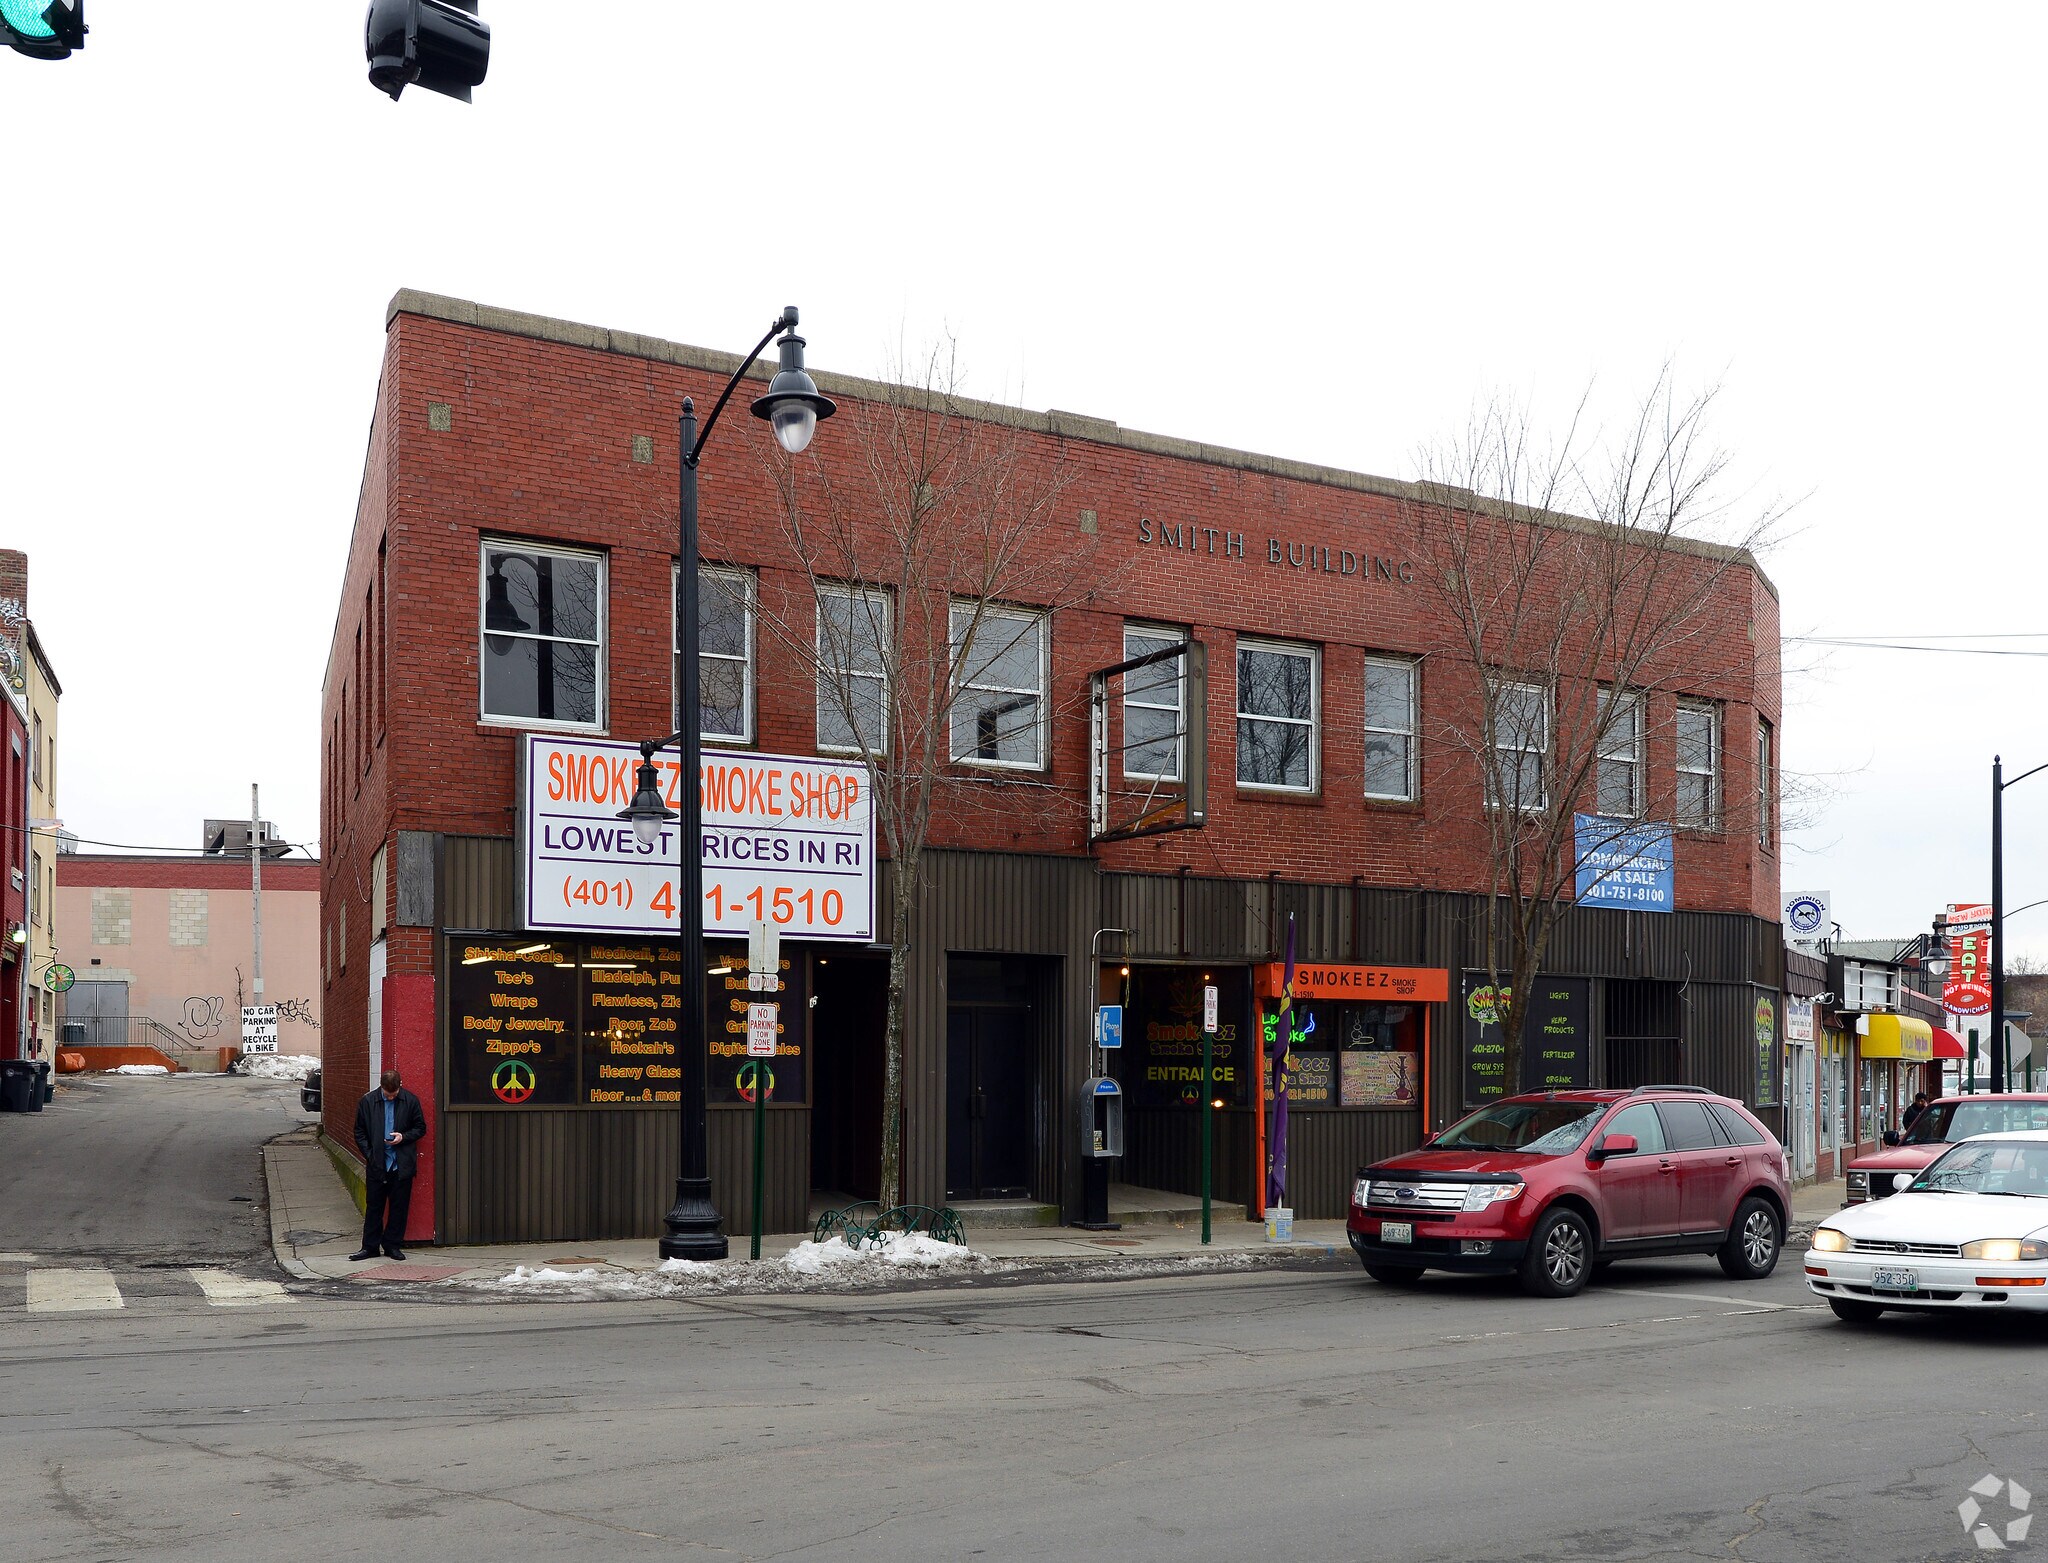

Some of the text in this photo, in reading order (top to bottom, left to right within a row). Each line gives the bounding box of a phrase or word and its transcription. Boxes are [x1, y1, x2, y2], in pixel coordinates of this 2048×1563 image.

[1138, 518, 1414, 584] SMITH BUILDING
[789, 771, 859, 821] SHOP
[701, 834, 790, 862] RICES
[799, 840, 826, 864] IN
[835, 842, 860, 866] RI
[1581, 851, 1667, 870] COMMERCIAL
[1595, 868, 1656, 885] FOR SALE
[563, 875, 844, 926] (401) 41-1510
[1785, 896, 1826, 913] DOMINION
[1802, 923, 1823, 934] Control
[1961, 936, 1978, 983] EAT
[494, 970, 534, 985] Tee's
[750, 977, 777, 988] TOW ZONE
[1299, 970, 1417, 987] SMOKEEZ SMOKE
[1396, 987, 1416, 995] SHOP
[1549, 992, 1570, 1000] LIGHTS
[1944, 983, 1991, 998] HOT WEINERS
[490, 993, 539, 1010] Wraps
[592, 993, 658, 1010] Flawless,
[1944, 1002, 1989, 1014] SANDWICHES
[243, 1007, 274, 1016] NO CAR
[757, 1008, 768, 1018] NO
[1261, 1010, 1295, 1026] Lel
[242, 1017, 277, 1025] PARKING
[463, 1015, 565, 1033] Body Jewelry
[609, 1017, 677, 1032] Roor, Zob
[750, 1020, 775, 1031] PARKING
[1106, 1022, 1119, 1030] Phone
[255, 1026, 266, 1034] AT
[1543, 1026, 1575, 1034] PRODUCTS
[242, 1035, 277, 1043] RECYCLE
[255, 1044, 274, 1052] BIKE
[486, 1039, 542, 1055] Zippo's
[610, 1041, 675, 1054] Hookah's
[709, 1042, 801, 1056] Digita ales
[1472, 1044, 1504, 1053] 401-270-
[1542, 1051, 1576, 1059] FERTILIZER
[600, 1064, 643, 1080] Heavy
[1472, 1063, 1491, 1071] GROW
[1299, 1073, 1328, 1087] Shop
[1545, 1075, 1572, 1084] ORGANIC
[655, 1090, 681, 1102] mor
[1874, 1271, 1915, 1286] 952-350
